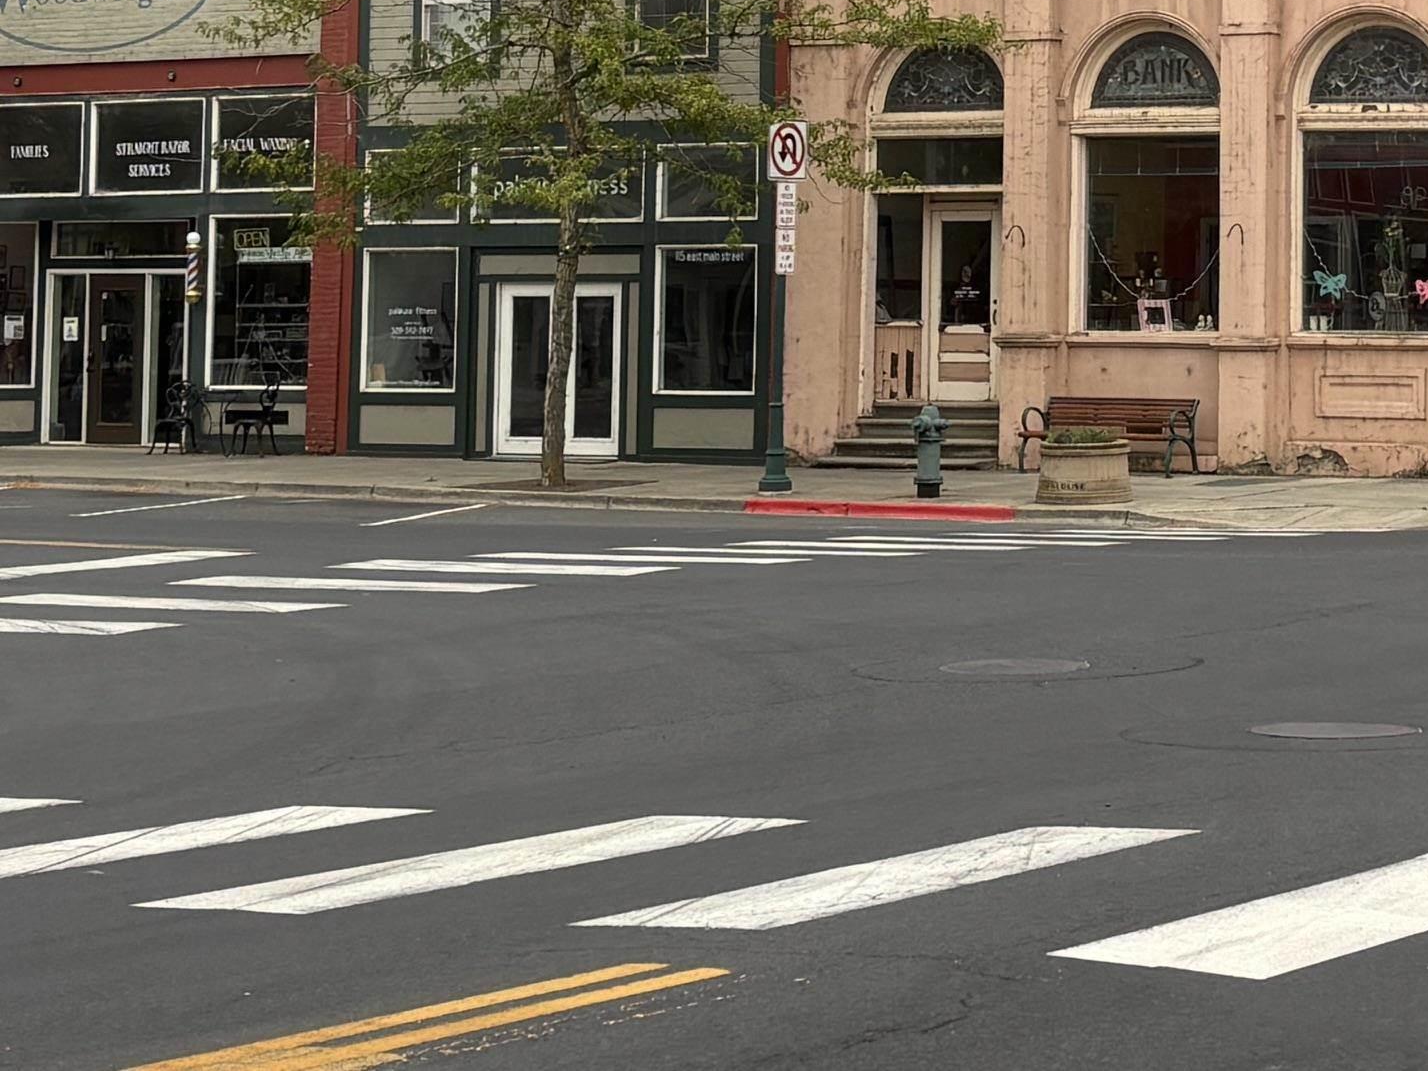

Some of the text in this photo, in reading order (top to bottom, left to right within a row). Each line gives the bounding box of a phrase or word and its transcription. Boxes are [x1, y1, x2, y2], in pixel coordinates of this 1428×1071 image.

[1121, 57, 1197, 90] BANK
[115, 139, 190, 156] STRAIGHT RAZOR
[128, 163, 171, 177] SERVICES
[236, 231, 269, 248] OPEN
[721, 251, 744, 262] street
